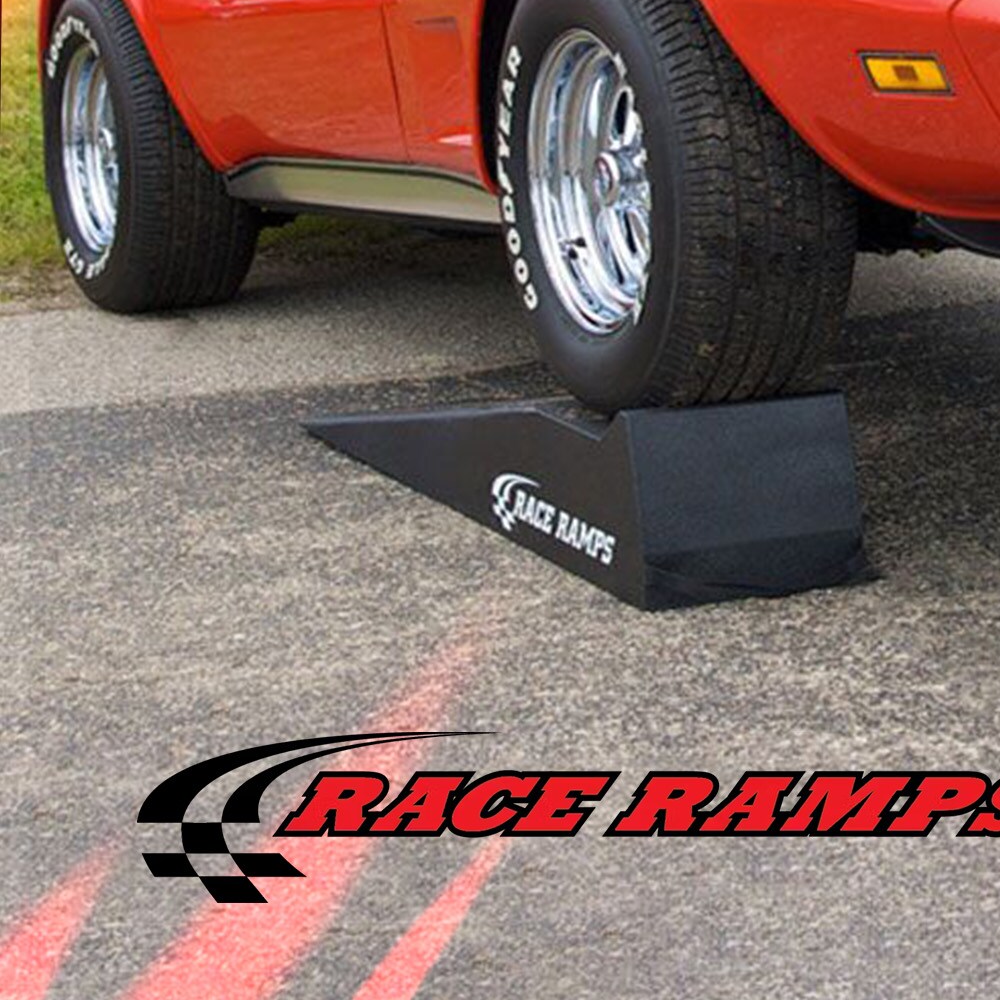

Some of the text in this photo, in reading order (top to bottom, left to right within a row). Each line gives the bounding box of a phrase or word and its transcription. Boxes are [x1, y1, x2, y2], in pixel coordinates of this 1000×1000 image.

[498, 45, 538, 311] GOODYEAR
[513, 489, 616, 565] RACE RAMPS
